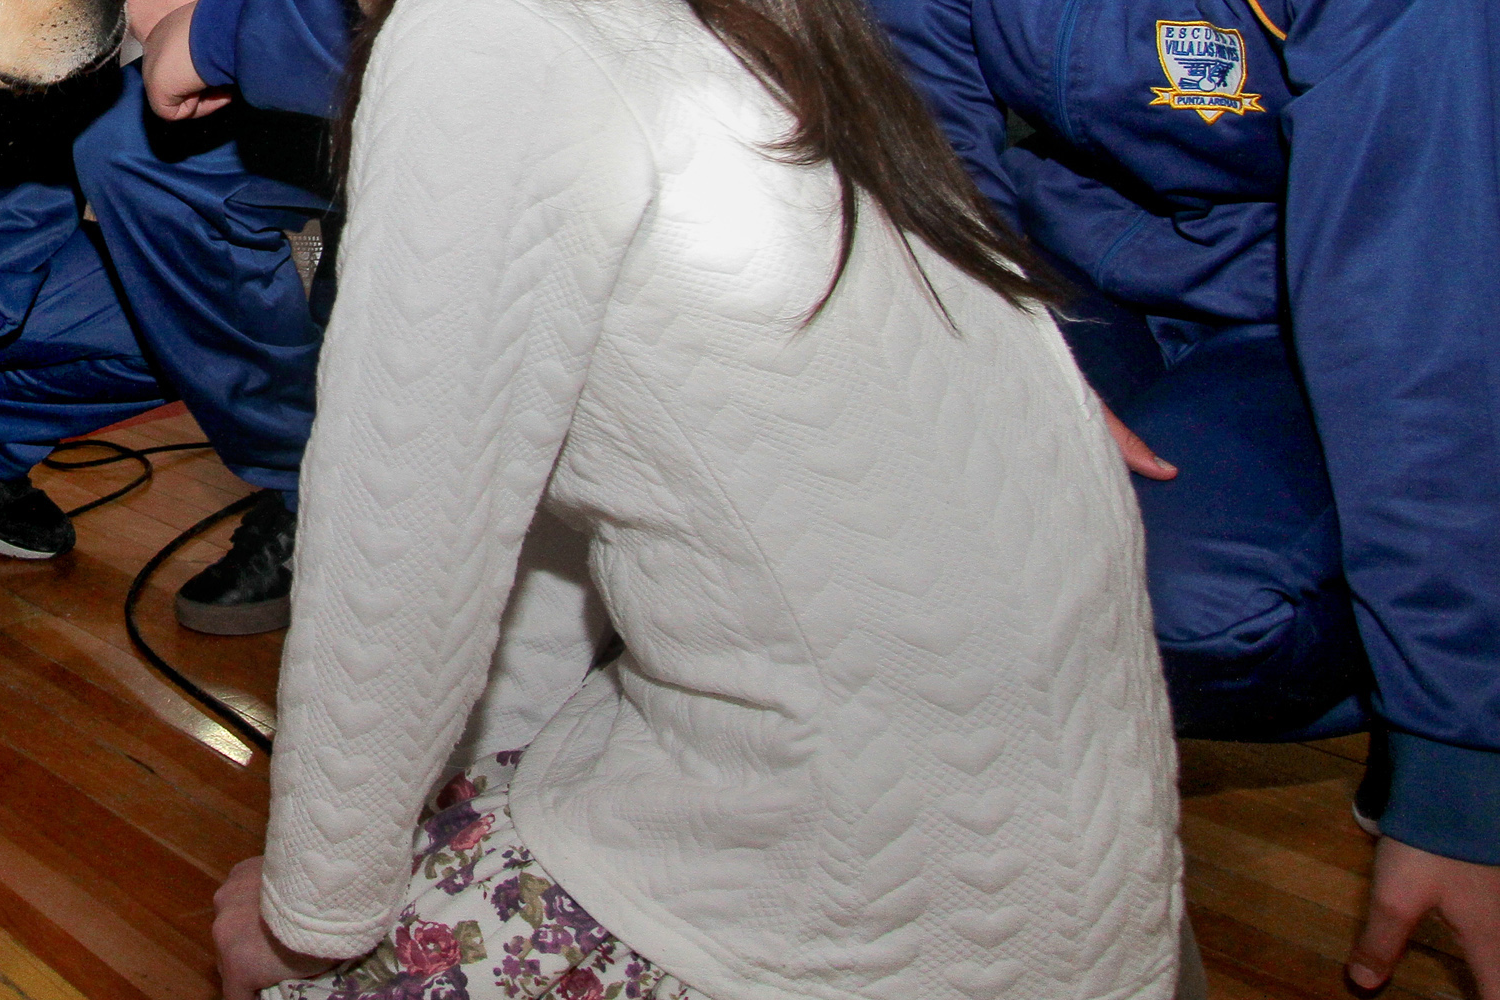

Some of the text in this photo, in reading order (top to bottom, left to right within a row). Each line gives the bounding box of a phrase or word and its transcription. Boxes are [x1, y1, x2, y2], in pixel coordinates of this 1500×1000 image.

[1165, 39, 1194, 56] VILLA
[1196, 40, 1215, 57] LAS
[1177, 96, 1205, 105] PUNTA
